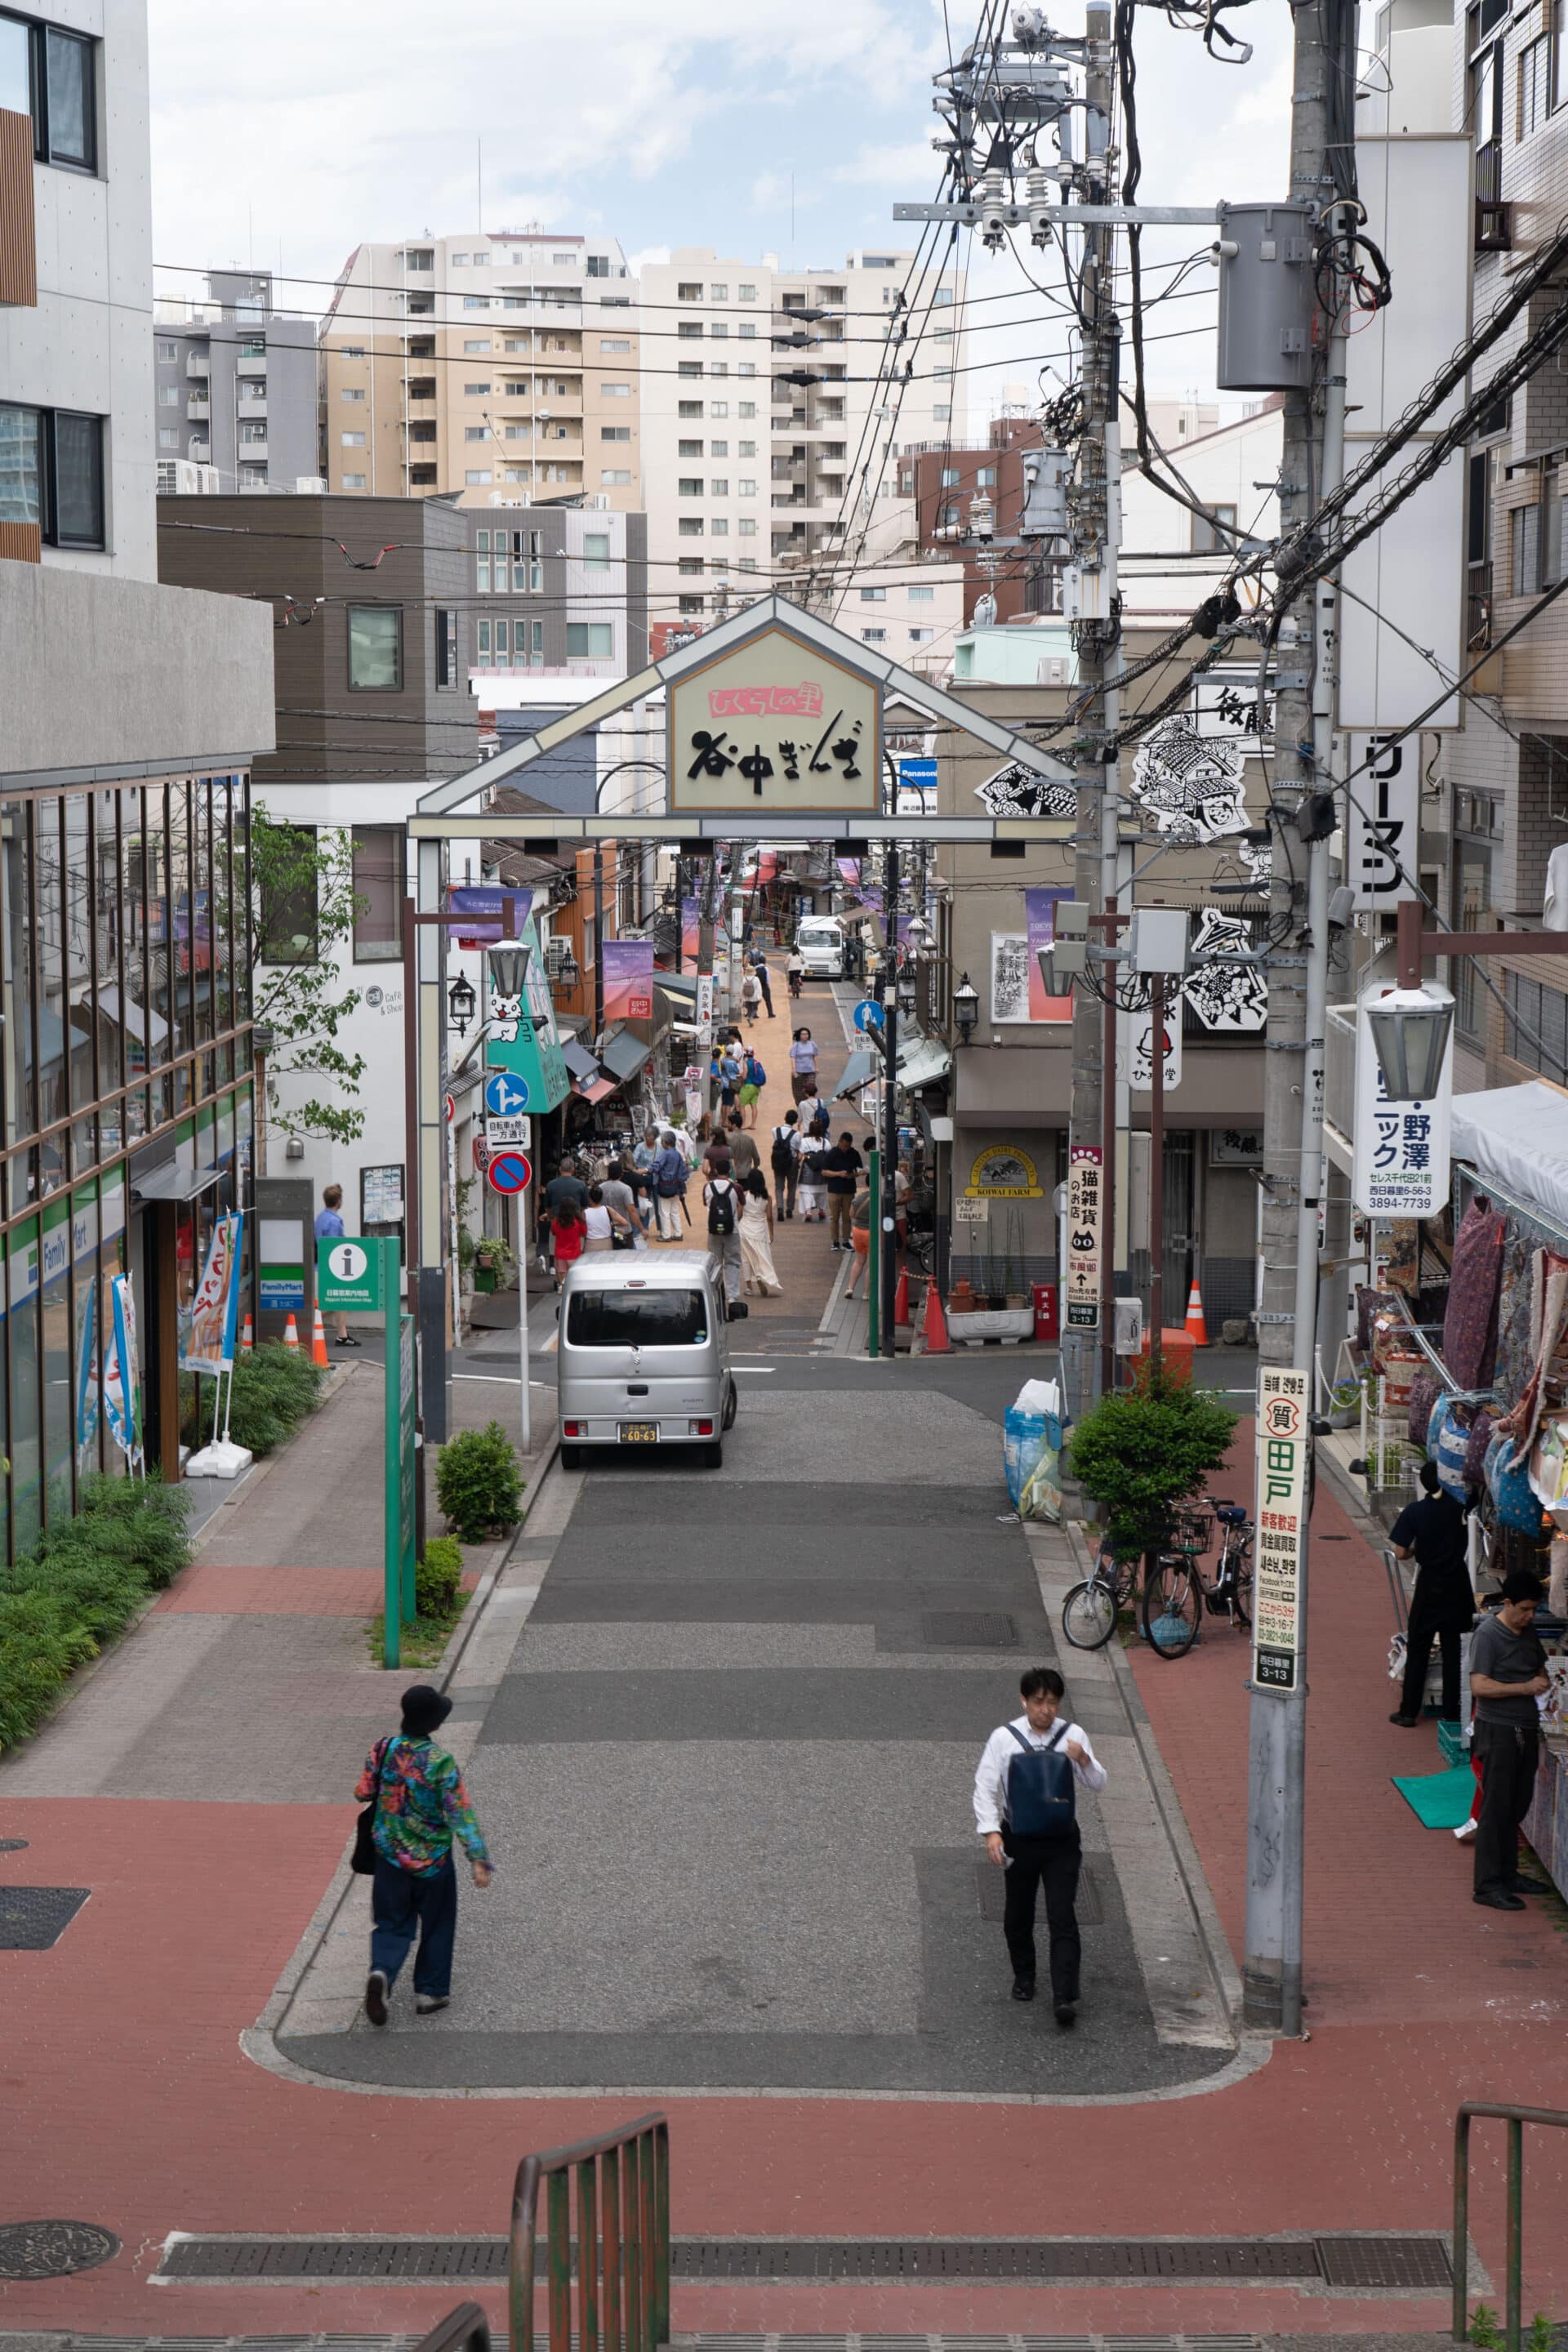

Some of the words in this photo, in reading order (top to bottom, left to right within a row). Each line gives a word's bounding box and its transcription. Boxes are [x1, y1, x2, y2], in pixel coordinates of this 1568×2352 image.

[710, 681, 822, 717] ひぐらしの里
[687, 709, 863, 795] 谷中ぎんざ
[490, 1129, 527, 1139] 一方通行
[1370, 1173, 1432, 1184] セレス千代田21前
[1081, 1170, 1098, 1225] 猫雑貨
[1370, 1185, 1432, 1196] 西日暮里6-56-3
[1071, 1181, 1080, 1218] のお店
[1369, 1197, 1432, 1209] 3894-7739
[261, 1283, 302, 1292] FamilyMart
[1071, 1315, 1090, 1324] 3-13
[1272, 1405, 1291, 1428] 質
[1266, 1440, 1294, 1505] 田戸
[1258, 1601, 1294, 1619] ここから3分
[1258, 1615, 1294, 1631] 谷中3-16-7
[1260, 1655, 1290, 1669] 西日暮里
[1261, 1667, 1288, 1681] 3-13
